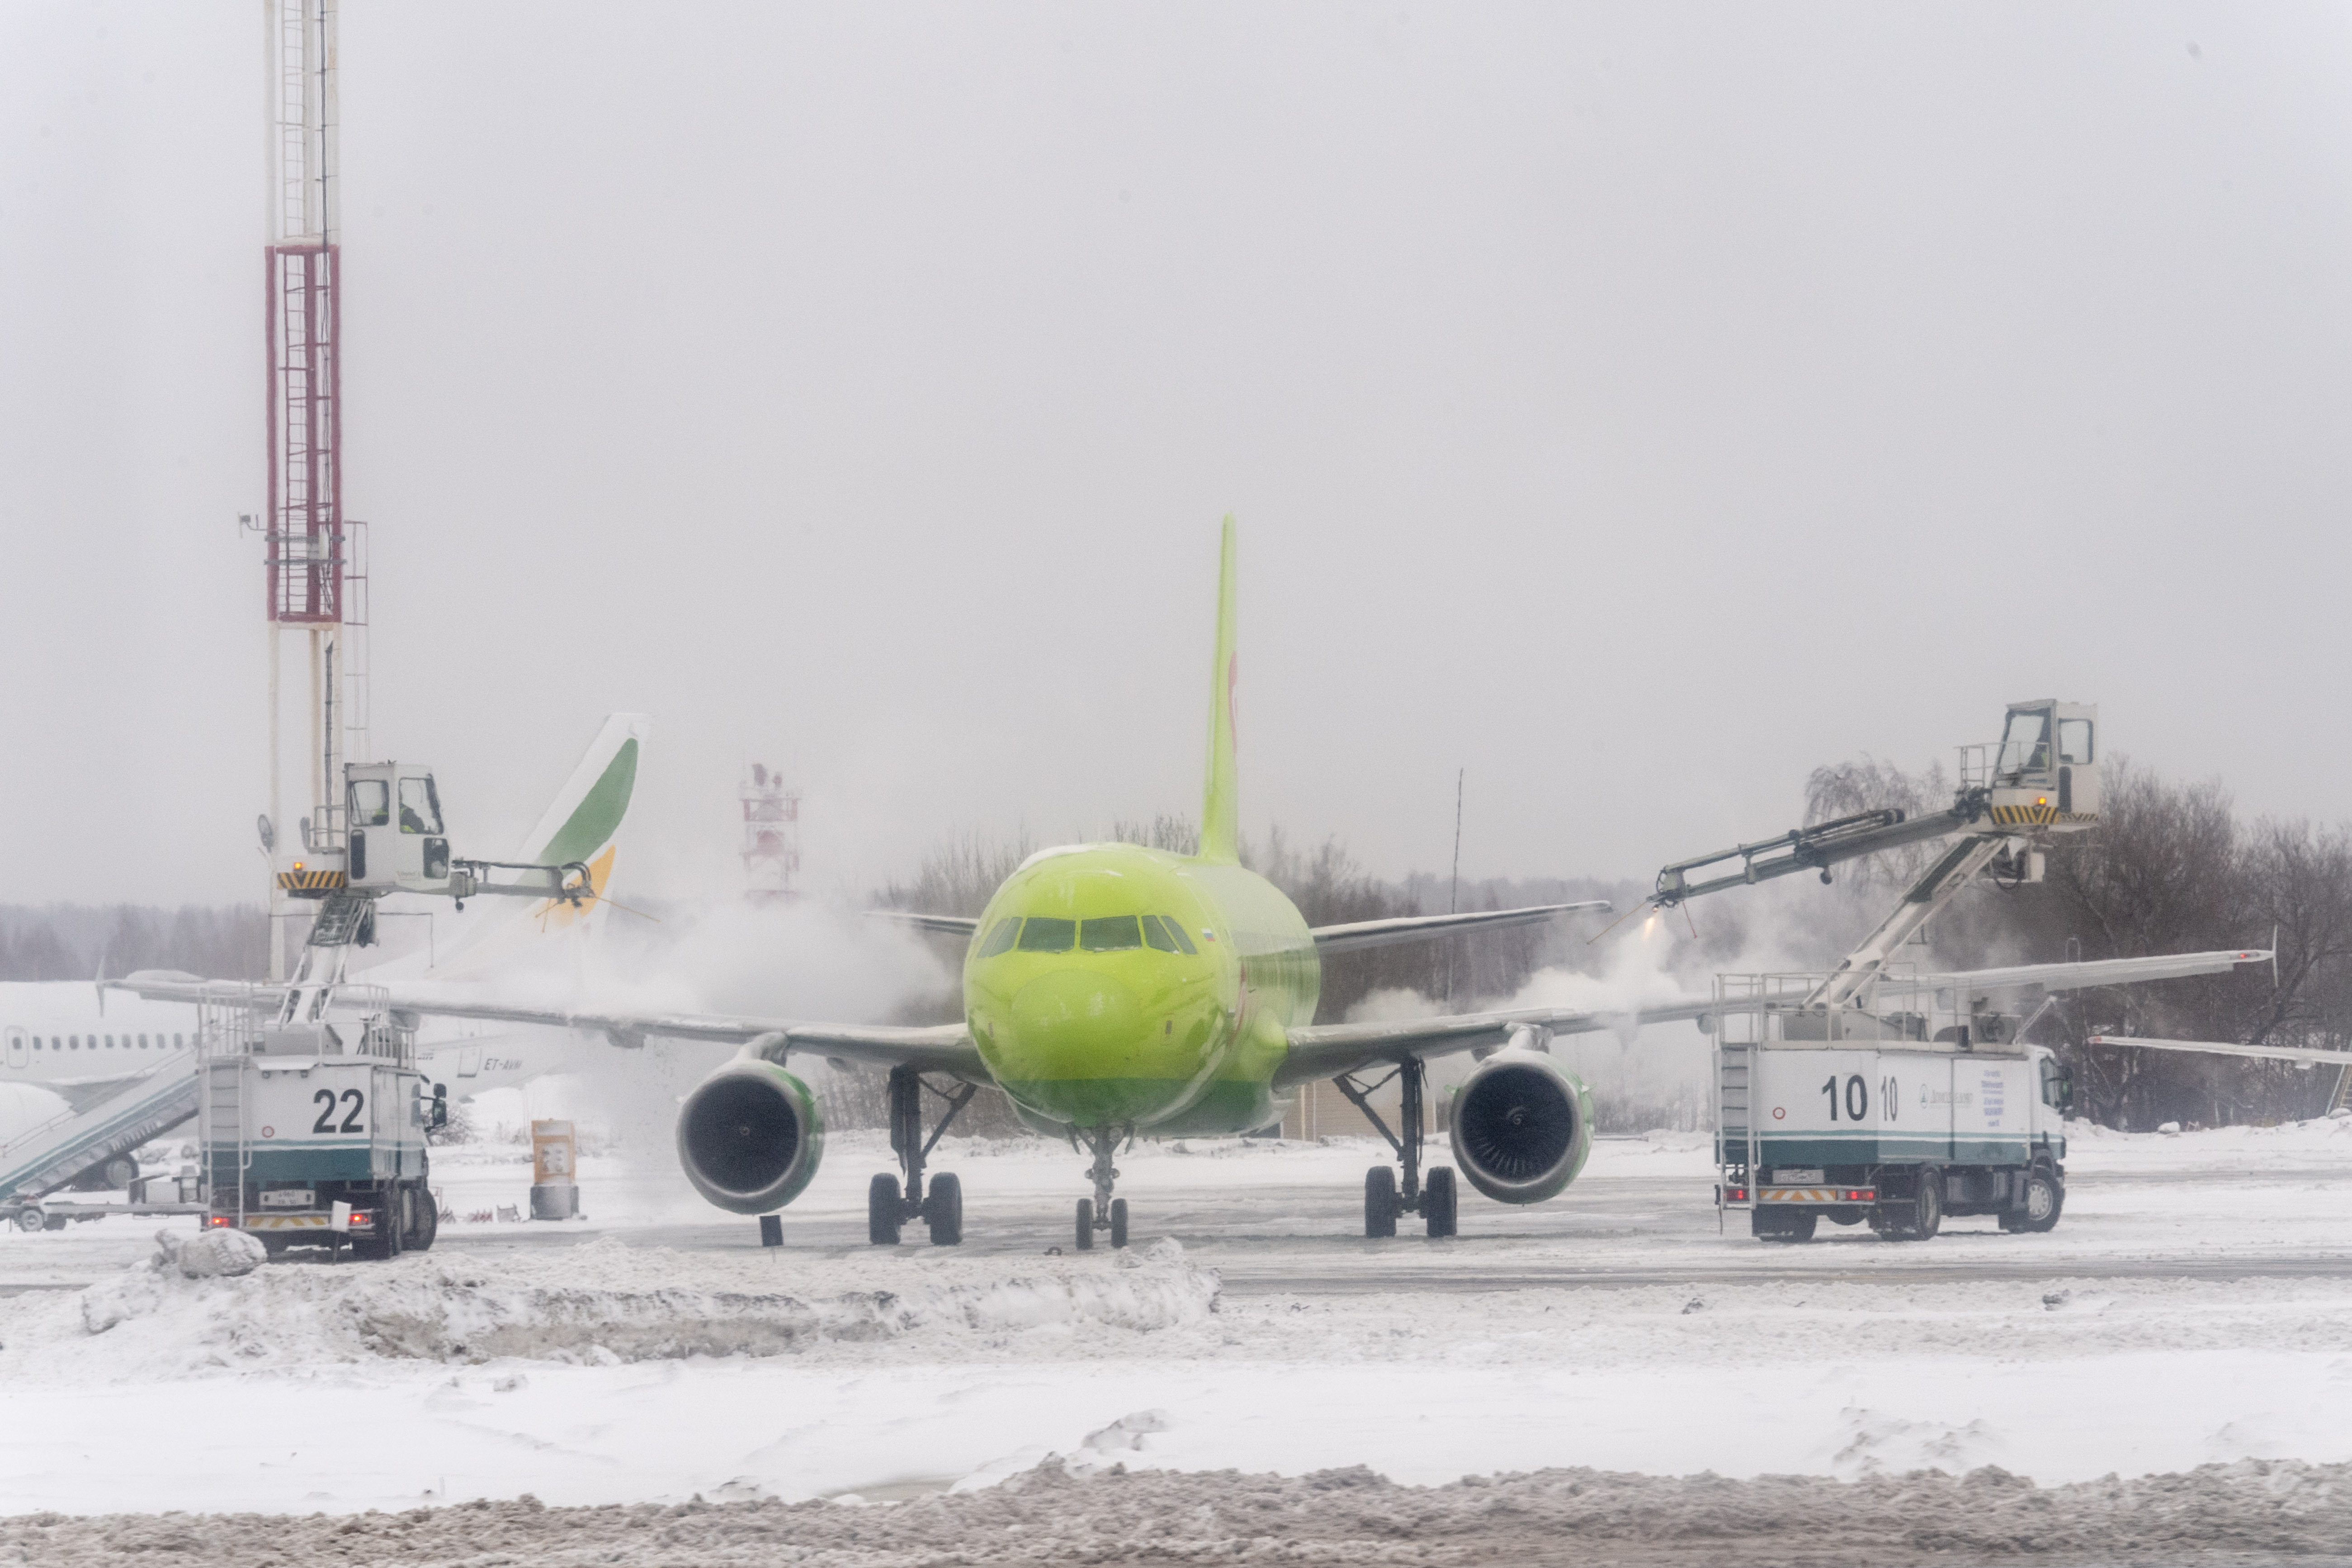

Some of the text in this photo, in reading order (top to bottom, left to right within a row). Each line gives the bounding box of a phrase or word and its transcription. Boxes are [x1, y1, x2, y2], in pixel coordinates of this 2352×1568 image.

[313, 1089, 364, 1133] 22
[1822, 1074, 1867, 1121] 10
[1881, 1076, 1898, 1121] 10
